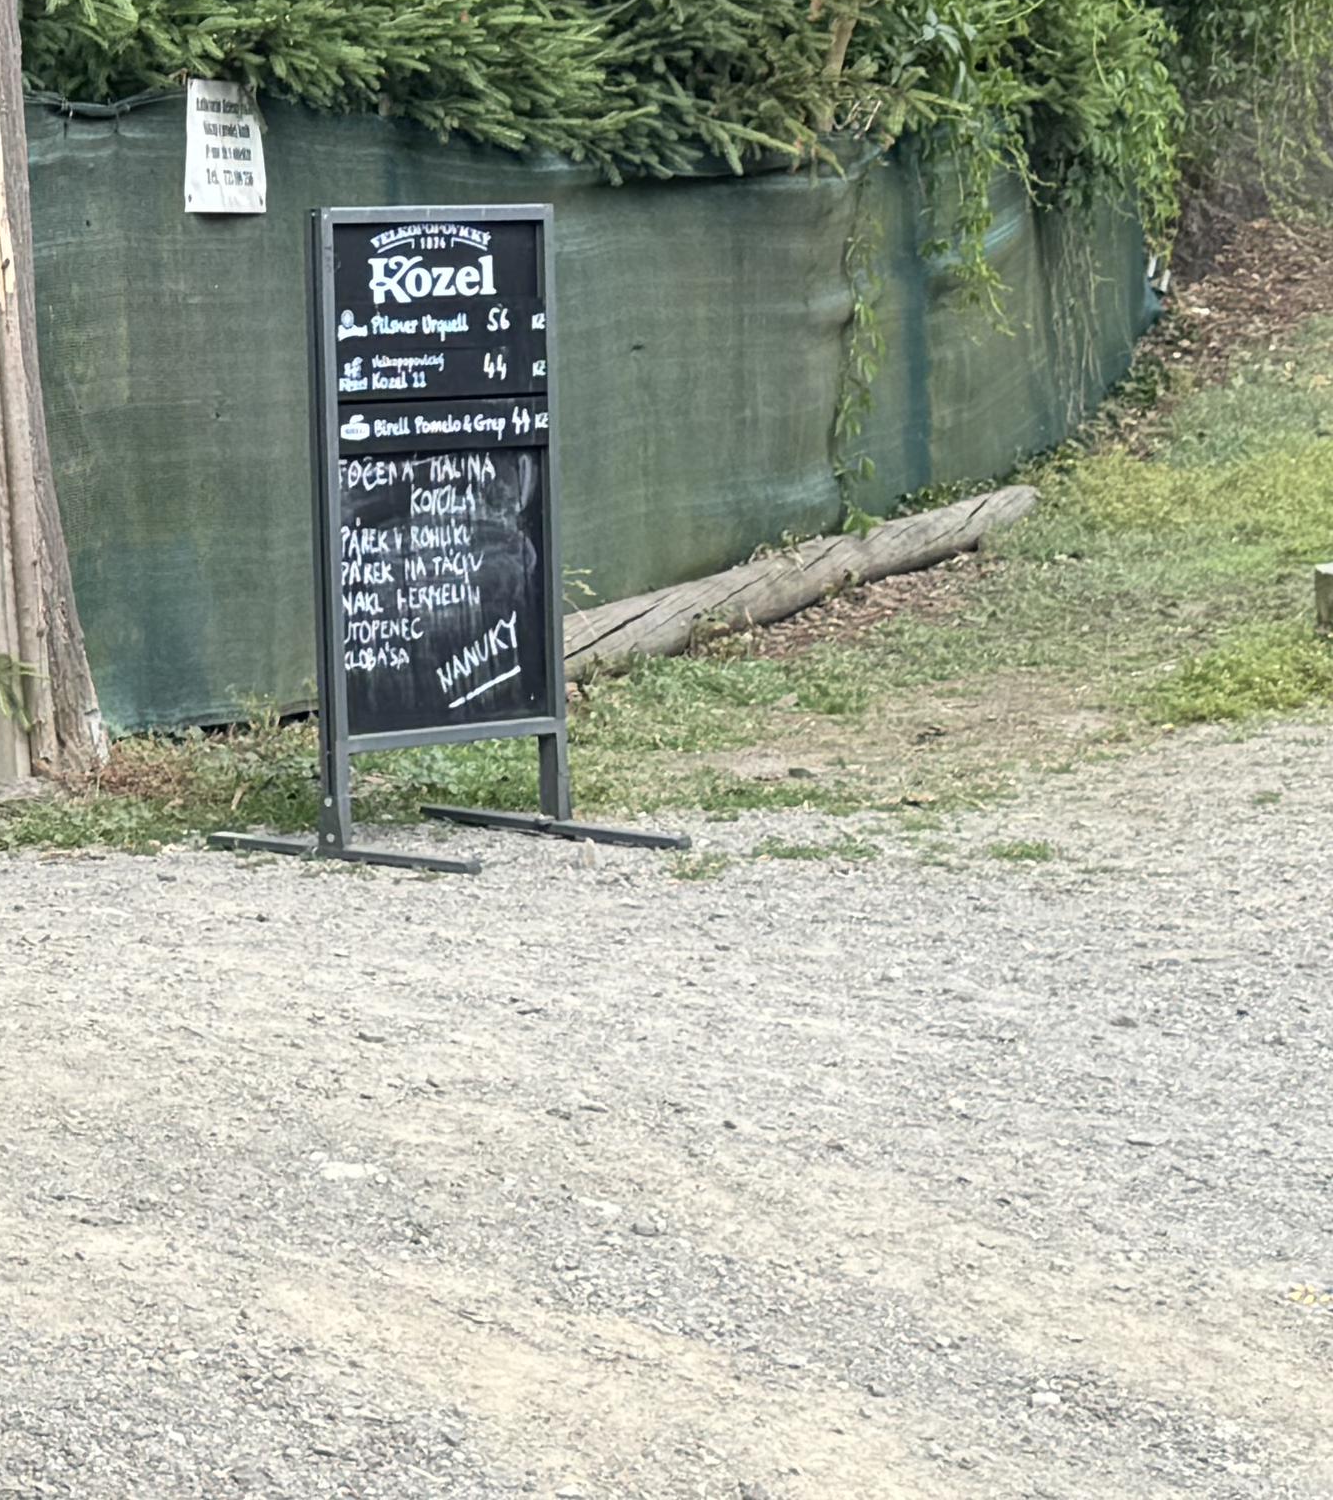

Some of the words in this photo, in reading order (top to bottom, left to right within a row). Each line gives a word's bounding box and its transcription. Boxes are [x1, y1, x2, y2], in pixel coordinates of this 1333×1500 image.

[368, 255, 497, 304] Kozel
[371, 313, 418, 334] Pilsner
[422, 312, 469, 342] Urquell
[487, 307, 511, 331] 56
[372, 371, 408, 390] Kozel
[483, 353, 508, 380] 44
[374, 414, 411, 437] Birell
[436, 611, 518, 693] NANUKY
